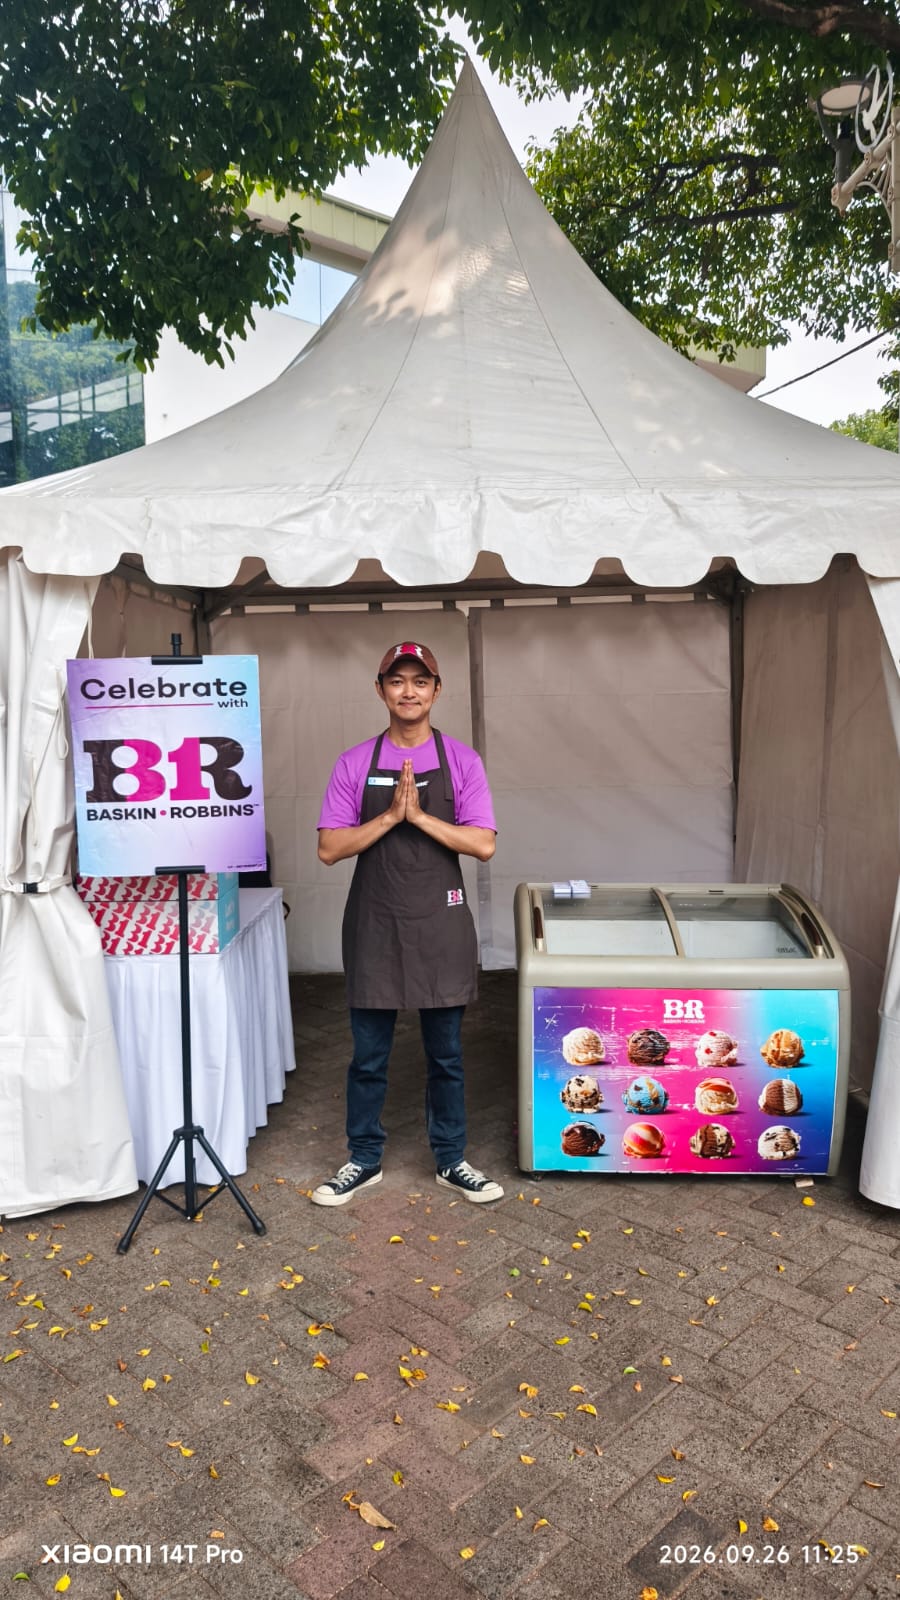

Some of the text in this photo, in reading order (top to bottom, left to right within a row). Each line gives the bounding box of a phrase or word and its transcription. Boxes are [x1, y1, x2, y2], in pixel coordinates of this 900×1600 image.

[80, 677, 247, 700] Celebrate
[218, 699, 248, 709] with
[86, 807, 157, 821] BASKIN
[104, 913, 129, 938] 31
[136, 906, 160, 931] 31
[127, 925, 152, 949] 31
